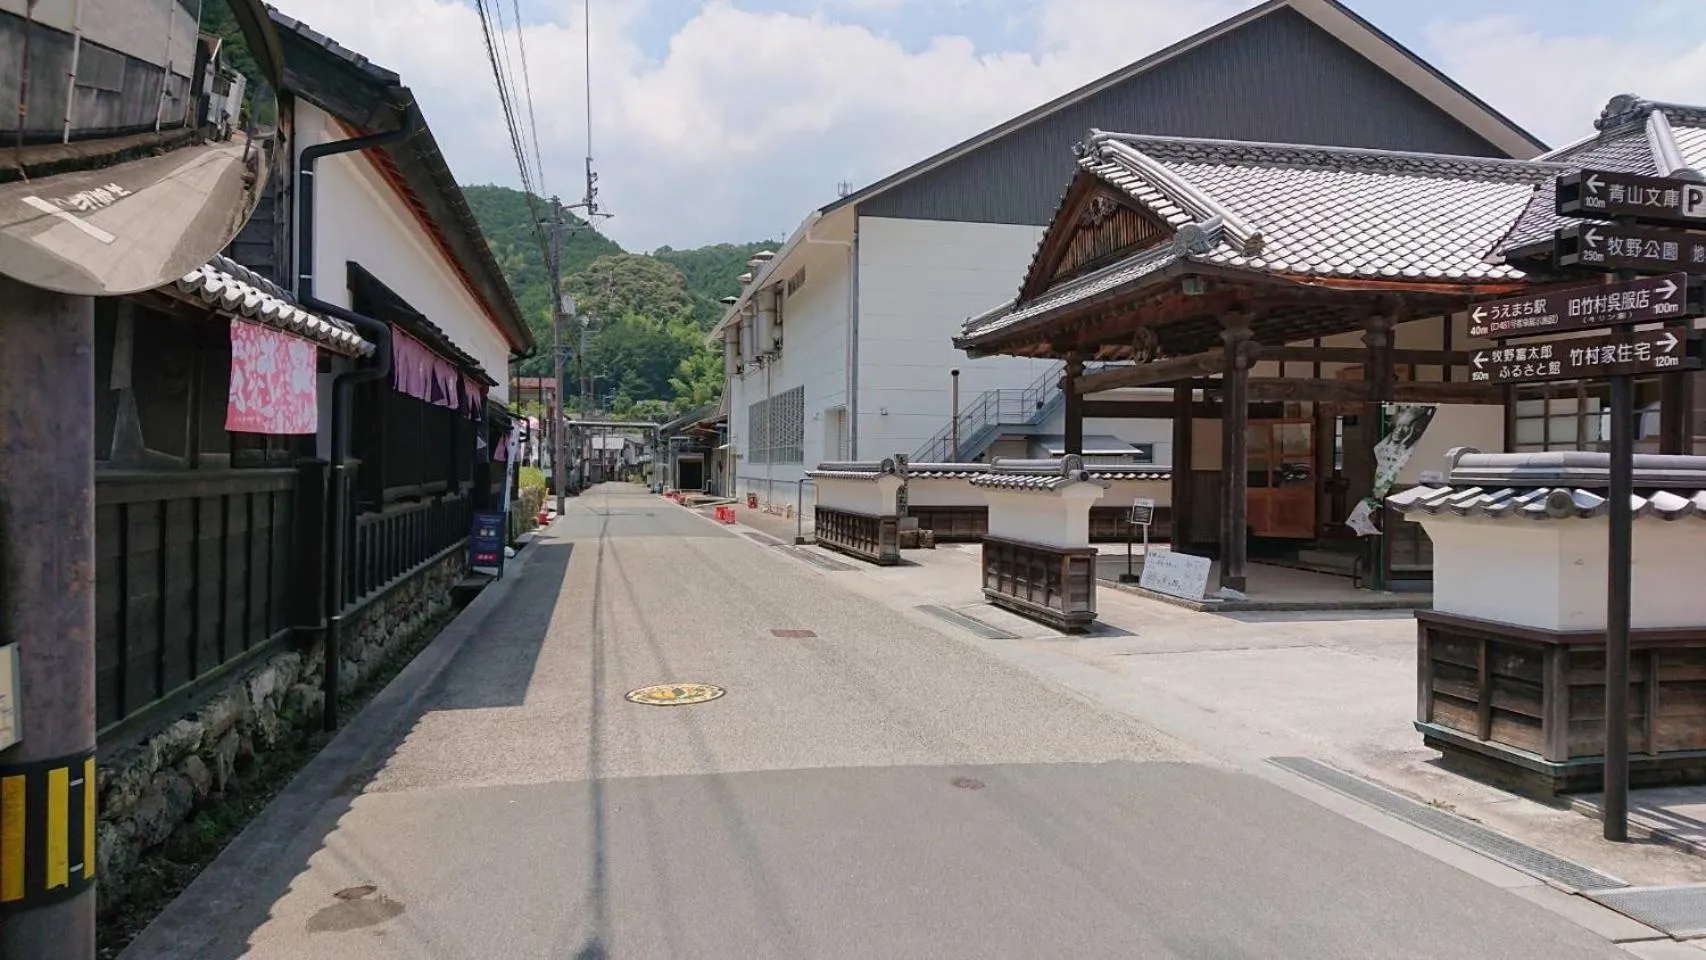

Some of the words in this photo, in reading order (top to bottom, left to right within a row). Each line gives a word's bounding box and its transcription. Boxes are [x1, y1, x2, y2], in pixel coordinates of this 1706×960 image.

[1585, 195, 1606, 208] 100m
[1609, 184, 1680, 208] 青山文庫
[1688, 188, 1704, 213] P
[1583, 249, 1605, 262] 250m
[1608, 236, 1679, 261] 牧野公園
[1490, 298, 1547, 320] うえまち駅
[1568, 288, 1651, 317] 旧竹村呉服店
[1654, 302, 1679, 315] 100m
[1470, 325, 1489, 336] 40m
[1491, 344, 1553, 363] 牧野富太郎
[1569, 342, 1651, 367] 竹村家住宅
[1655, 355, 1679, 368] 120m
[1499, 360, 1561, 379] ふるさと館
